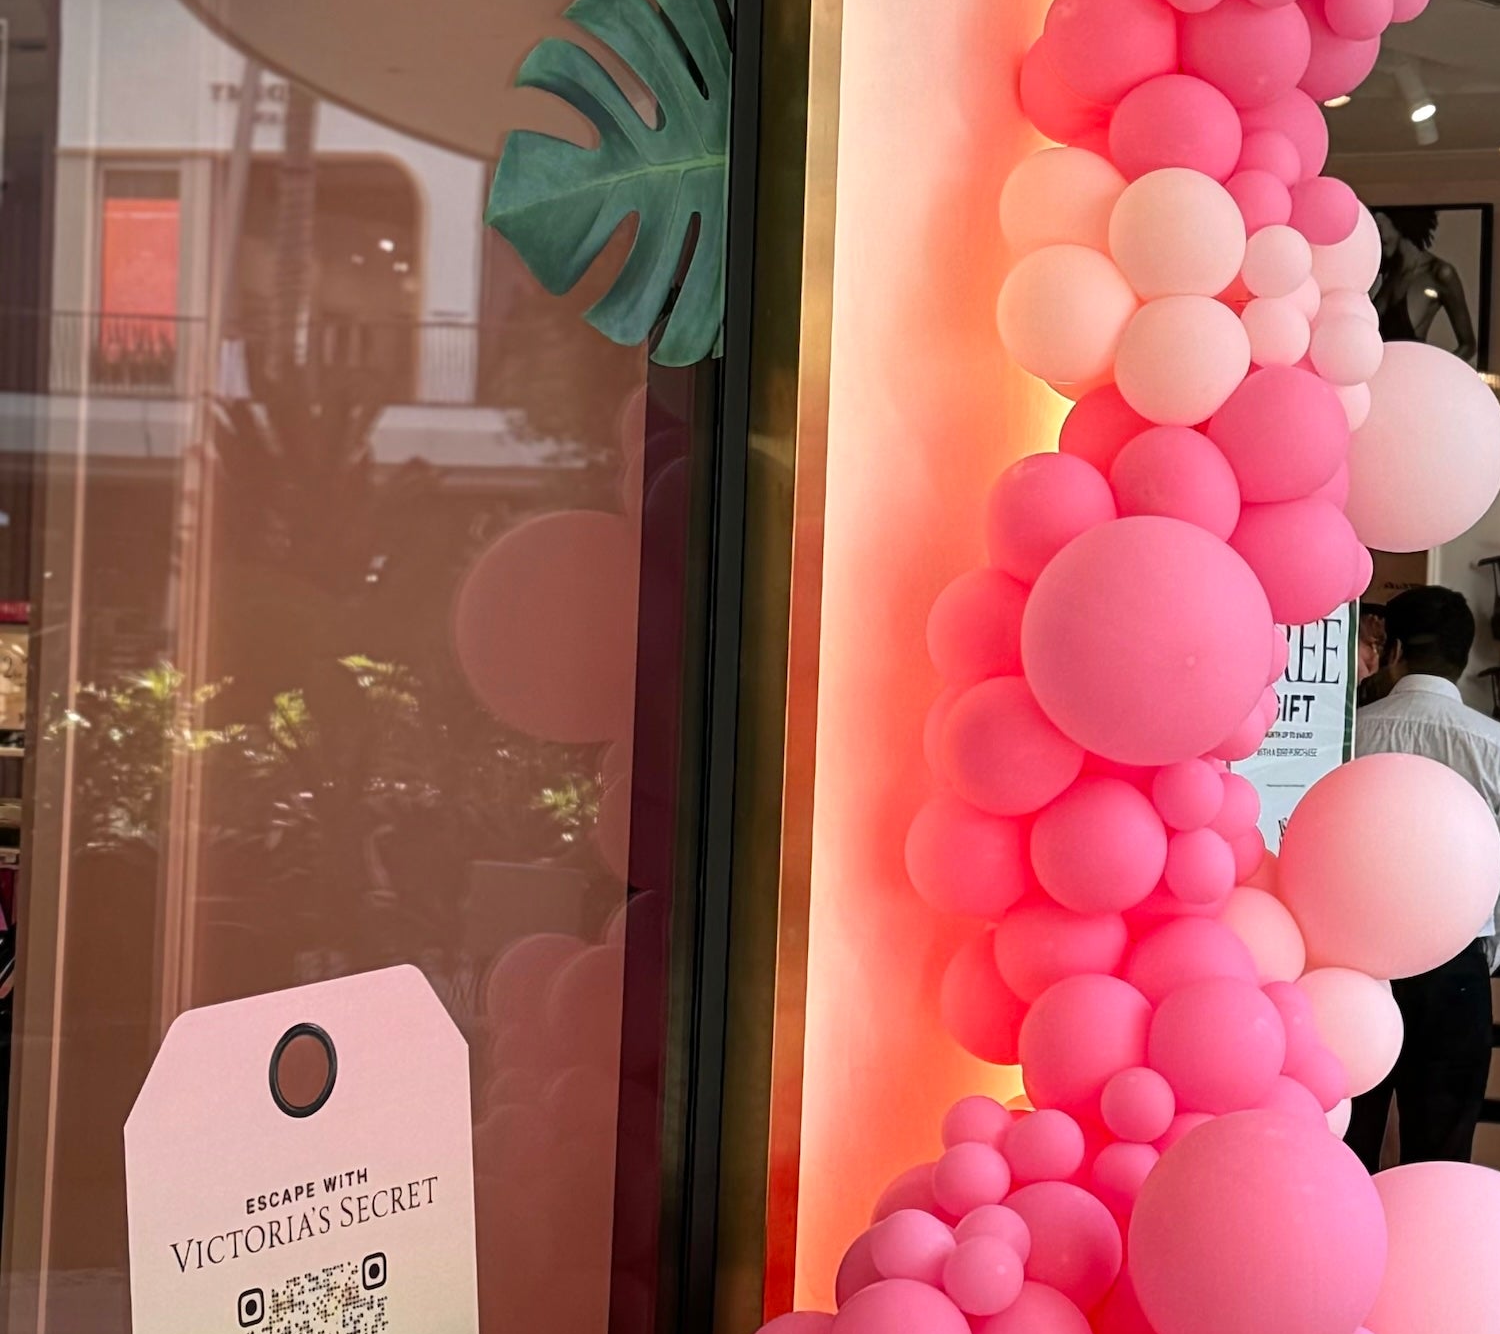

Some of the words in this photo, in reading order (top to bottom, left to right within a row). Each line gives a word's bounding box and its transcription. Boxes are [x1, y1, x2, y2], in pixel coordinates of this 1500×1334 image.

[1284, 618, 1342, 685] EE
[1276, 693, 1316, 723] IFT
[245, 1181, 316, 1215] ESCAPE
[322, 1167, 369, 1193] WITH
[169, 1205, 331, 1274] VICTORIA'S
[339, 1176, 439, 1228] SECRET
